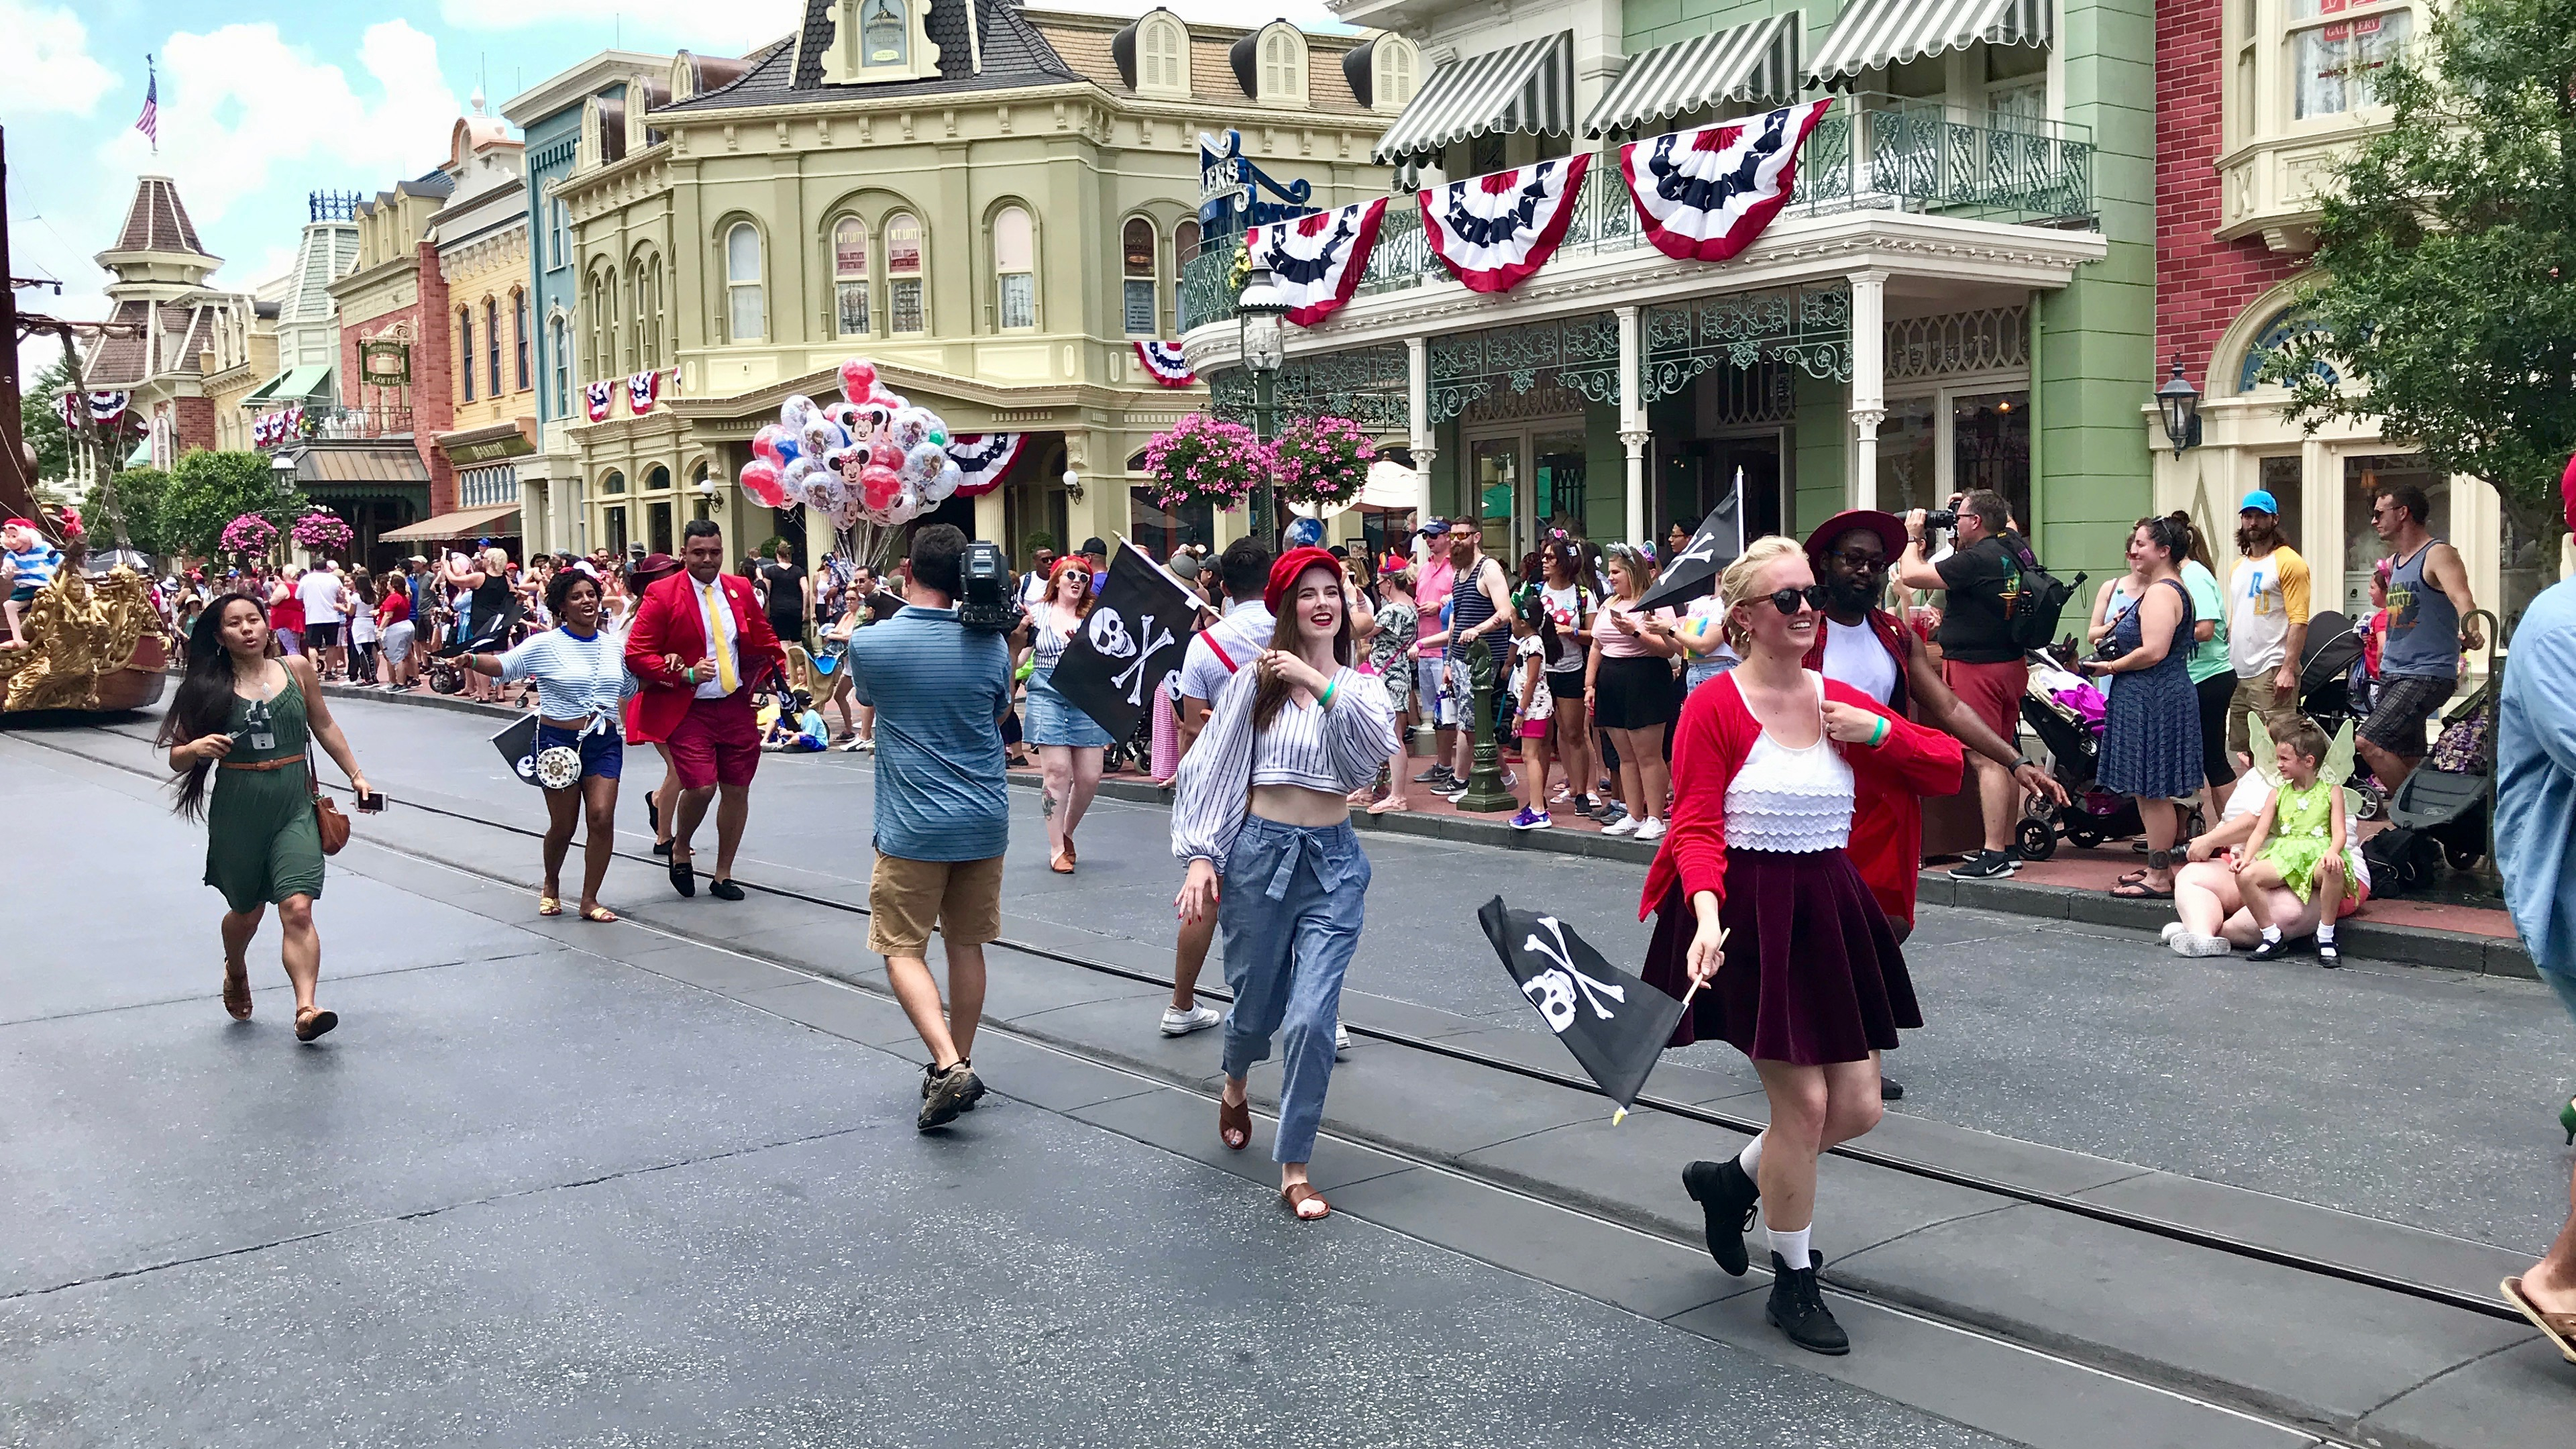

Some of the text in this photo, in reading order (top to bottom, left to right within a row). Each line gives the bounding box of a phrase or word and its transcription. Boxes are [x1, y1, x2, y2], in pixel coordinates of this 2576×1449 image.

[849, 231, 864, 243] LOTT
[902, 228, 918, 240] LOTT
[372, 375, 402, 384] COFFEE
[471, 441, 507, 460] BAKERY
